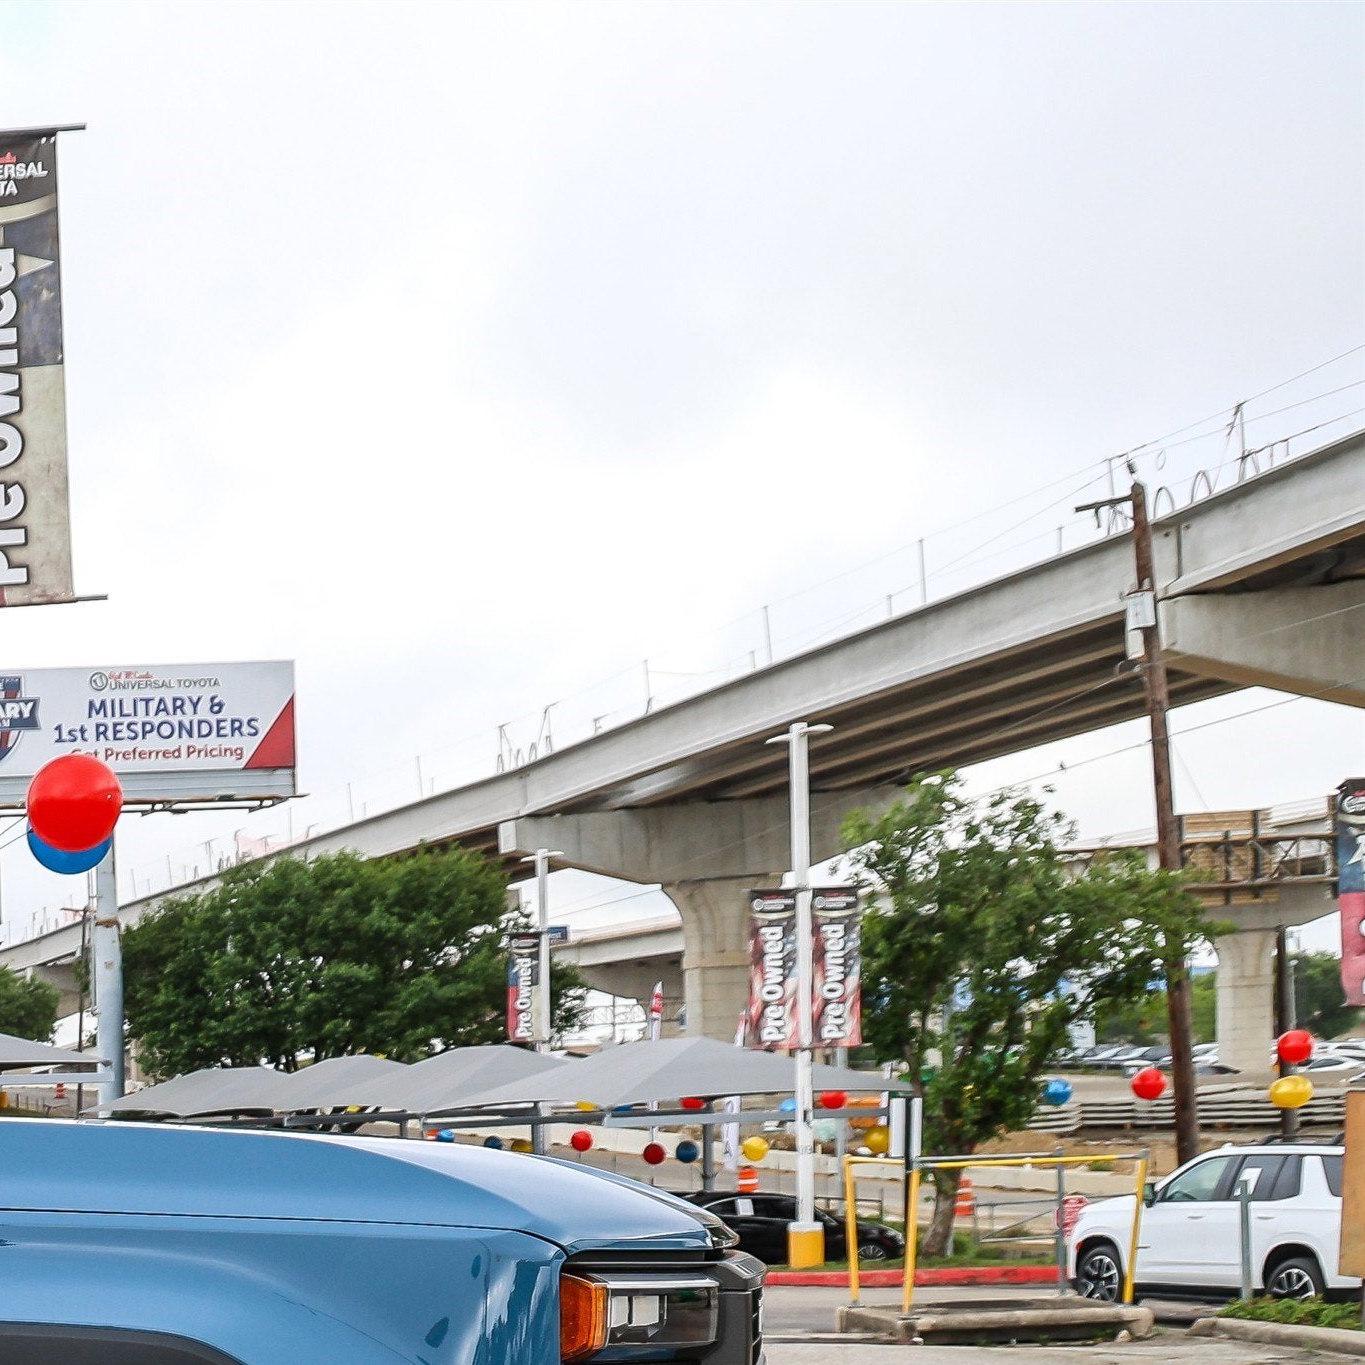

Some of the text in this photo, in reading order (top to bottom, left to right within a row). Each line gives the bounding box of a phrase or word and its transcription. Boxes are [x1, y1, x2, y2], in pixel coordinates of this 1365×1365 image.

[109, 677, 221, 690] UNIVERSAL TOYOTA
[88, 694, 226, 718] MILITARY &
[54, 717, 260, 743] 1st RESPONDERS
[105, 744, 181, 761] Preferred
[187, 744, 244, 761] Pricing
[759, 925, 785, 1001] Owned
[820, 924, 846, 999] Owned
[514, 957, 532, 1010] Owned
[514, 1011, 532, 1038] Pre
[760, 1004, 786, 1041] Pre
[821, 1002, 846, 1040] Pre
